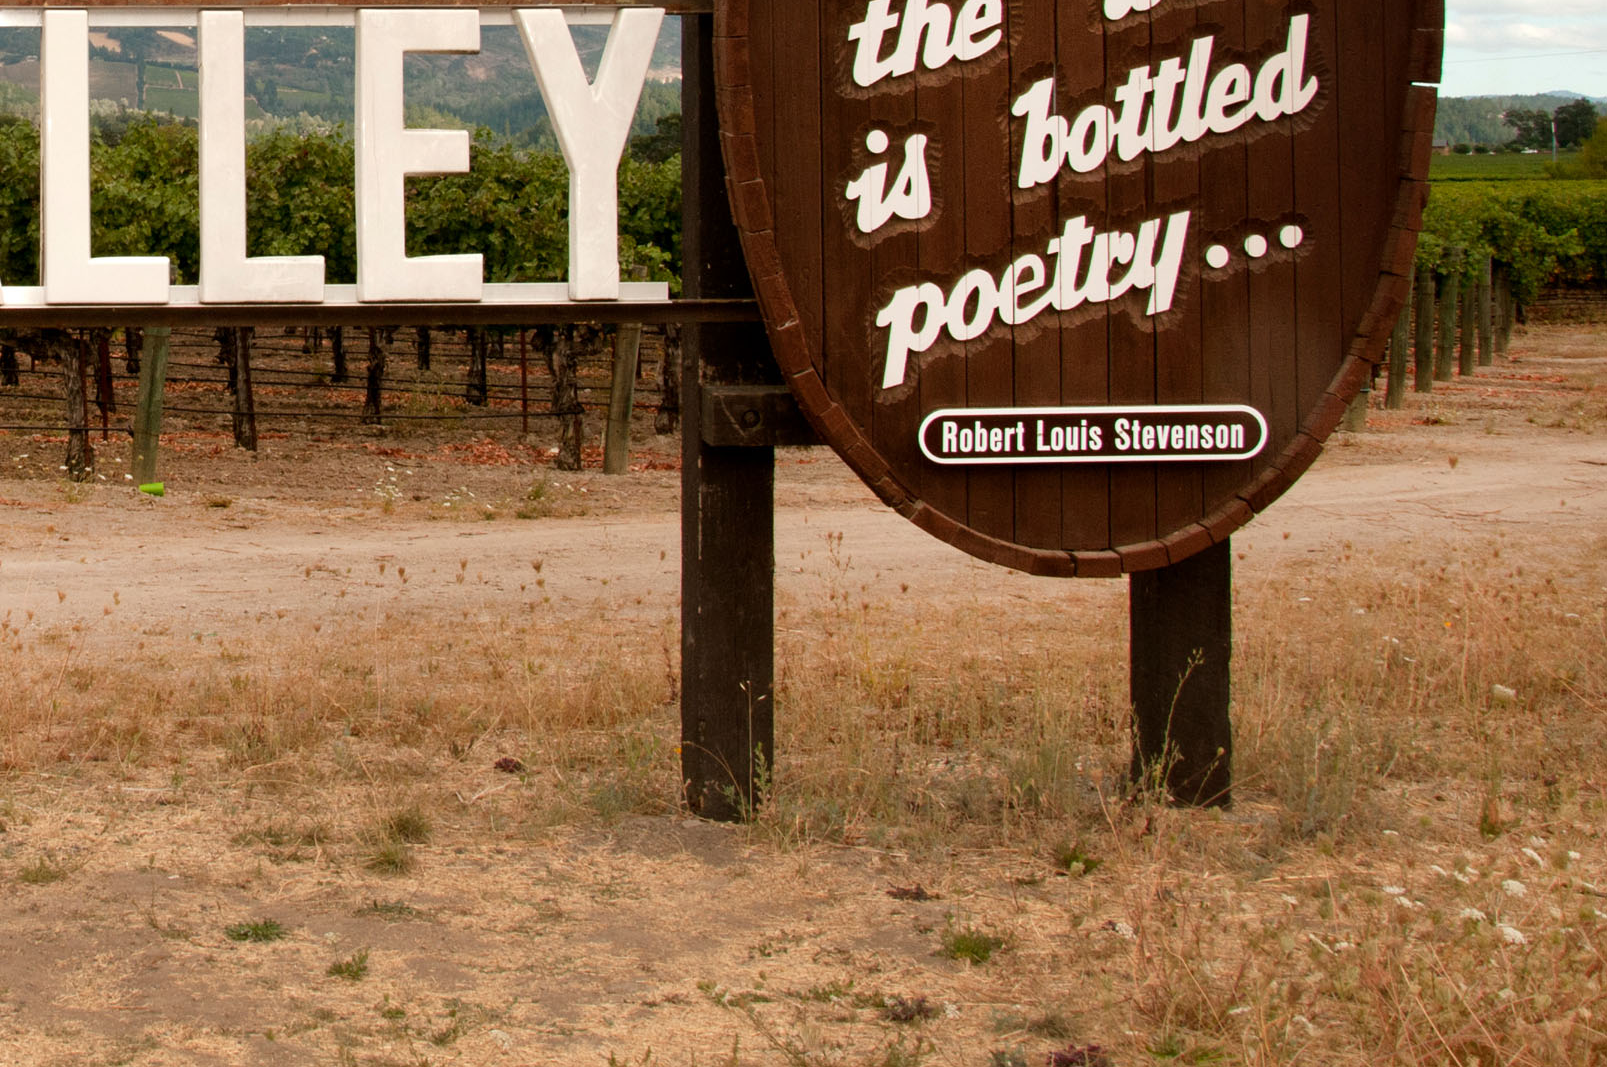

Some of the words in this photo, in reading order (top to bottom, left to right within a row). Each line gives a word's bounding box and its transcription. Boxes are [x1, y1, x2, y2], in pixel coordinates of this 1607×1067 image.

[845, 129, 932, 234] is
[1011, 13, 1319, 189] bottled
[942, 421, 1025, 453] Robert
[1036, 420, 1102, 452] Louis
[1114, 418, 1245, 451] Stevenson
